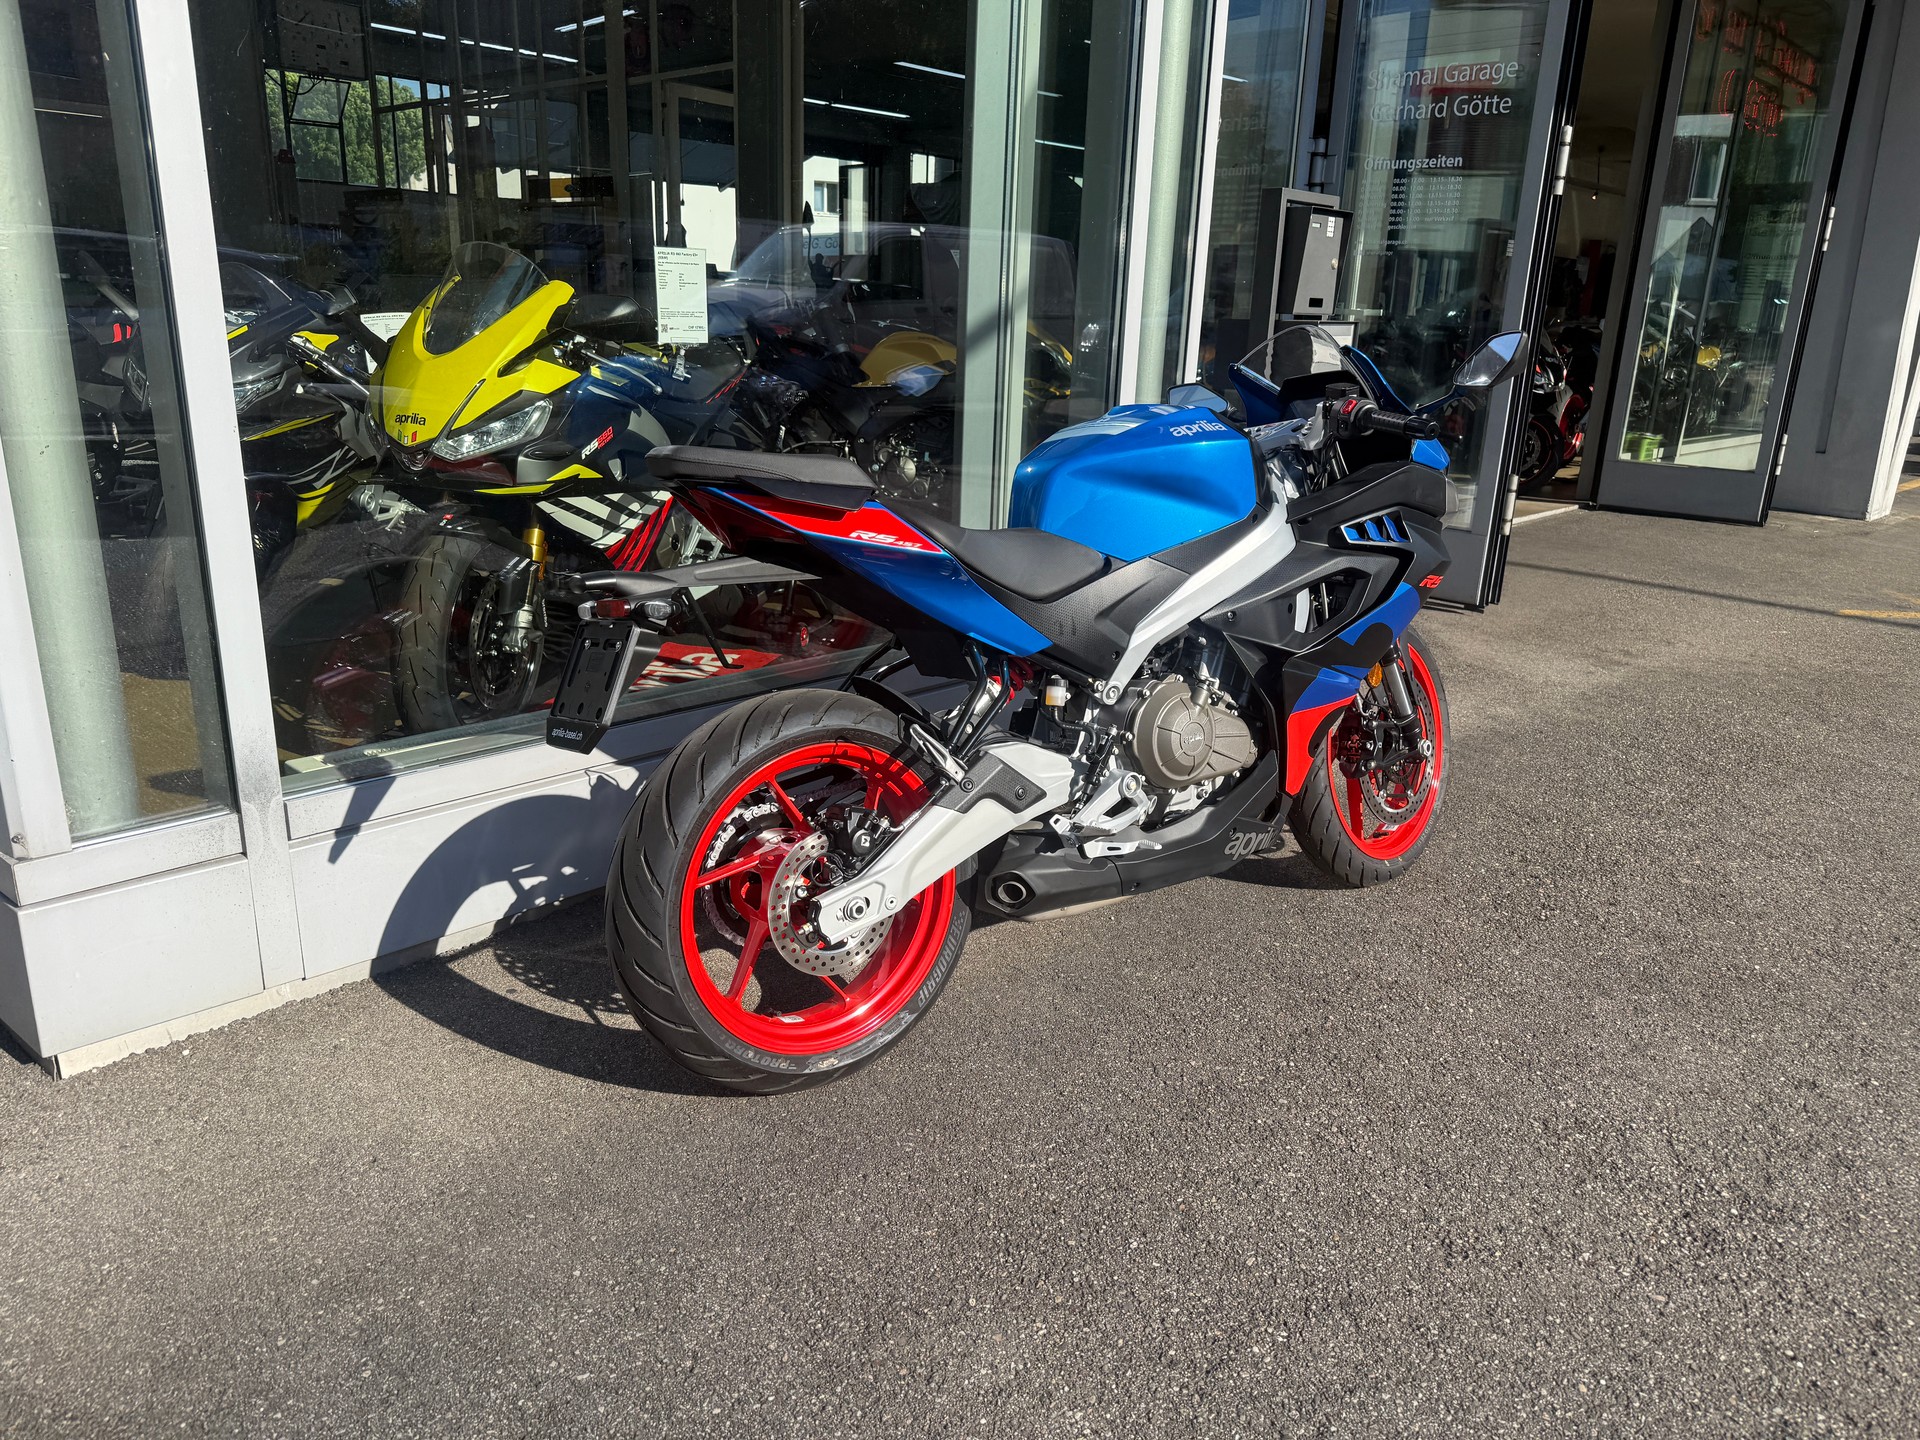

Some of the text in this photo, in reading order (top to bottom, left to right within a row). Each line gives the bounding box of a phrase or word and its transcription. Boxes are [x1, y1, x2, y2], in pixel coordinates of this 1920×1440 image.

[1367, 61, 1519, 90] Shamal Garage
[1370, 94, 1512, 122] Gerhard Götte
[395, 413, 427, 426] aprilia
[1169, 420, 1228, 437] aprilia
[1419, 574, 1444, 589] RS
[917, 923, 960, 1008] EUROGRIP
